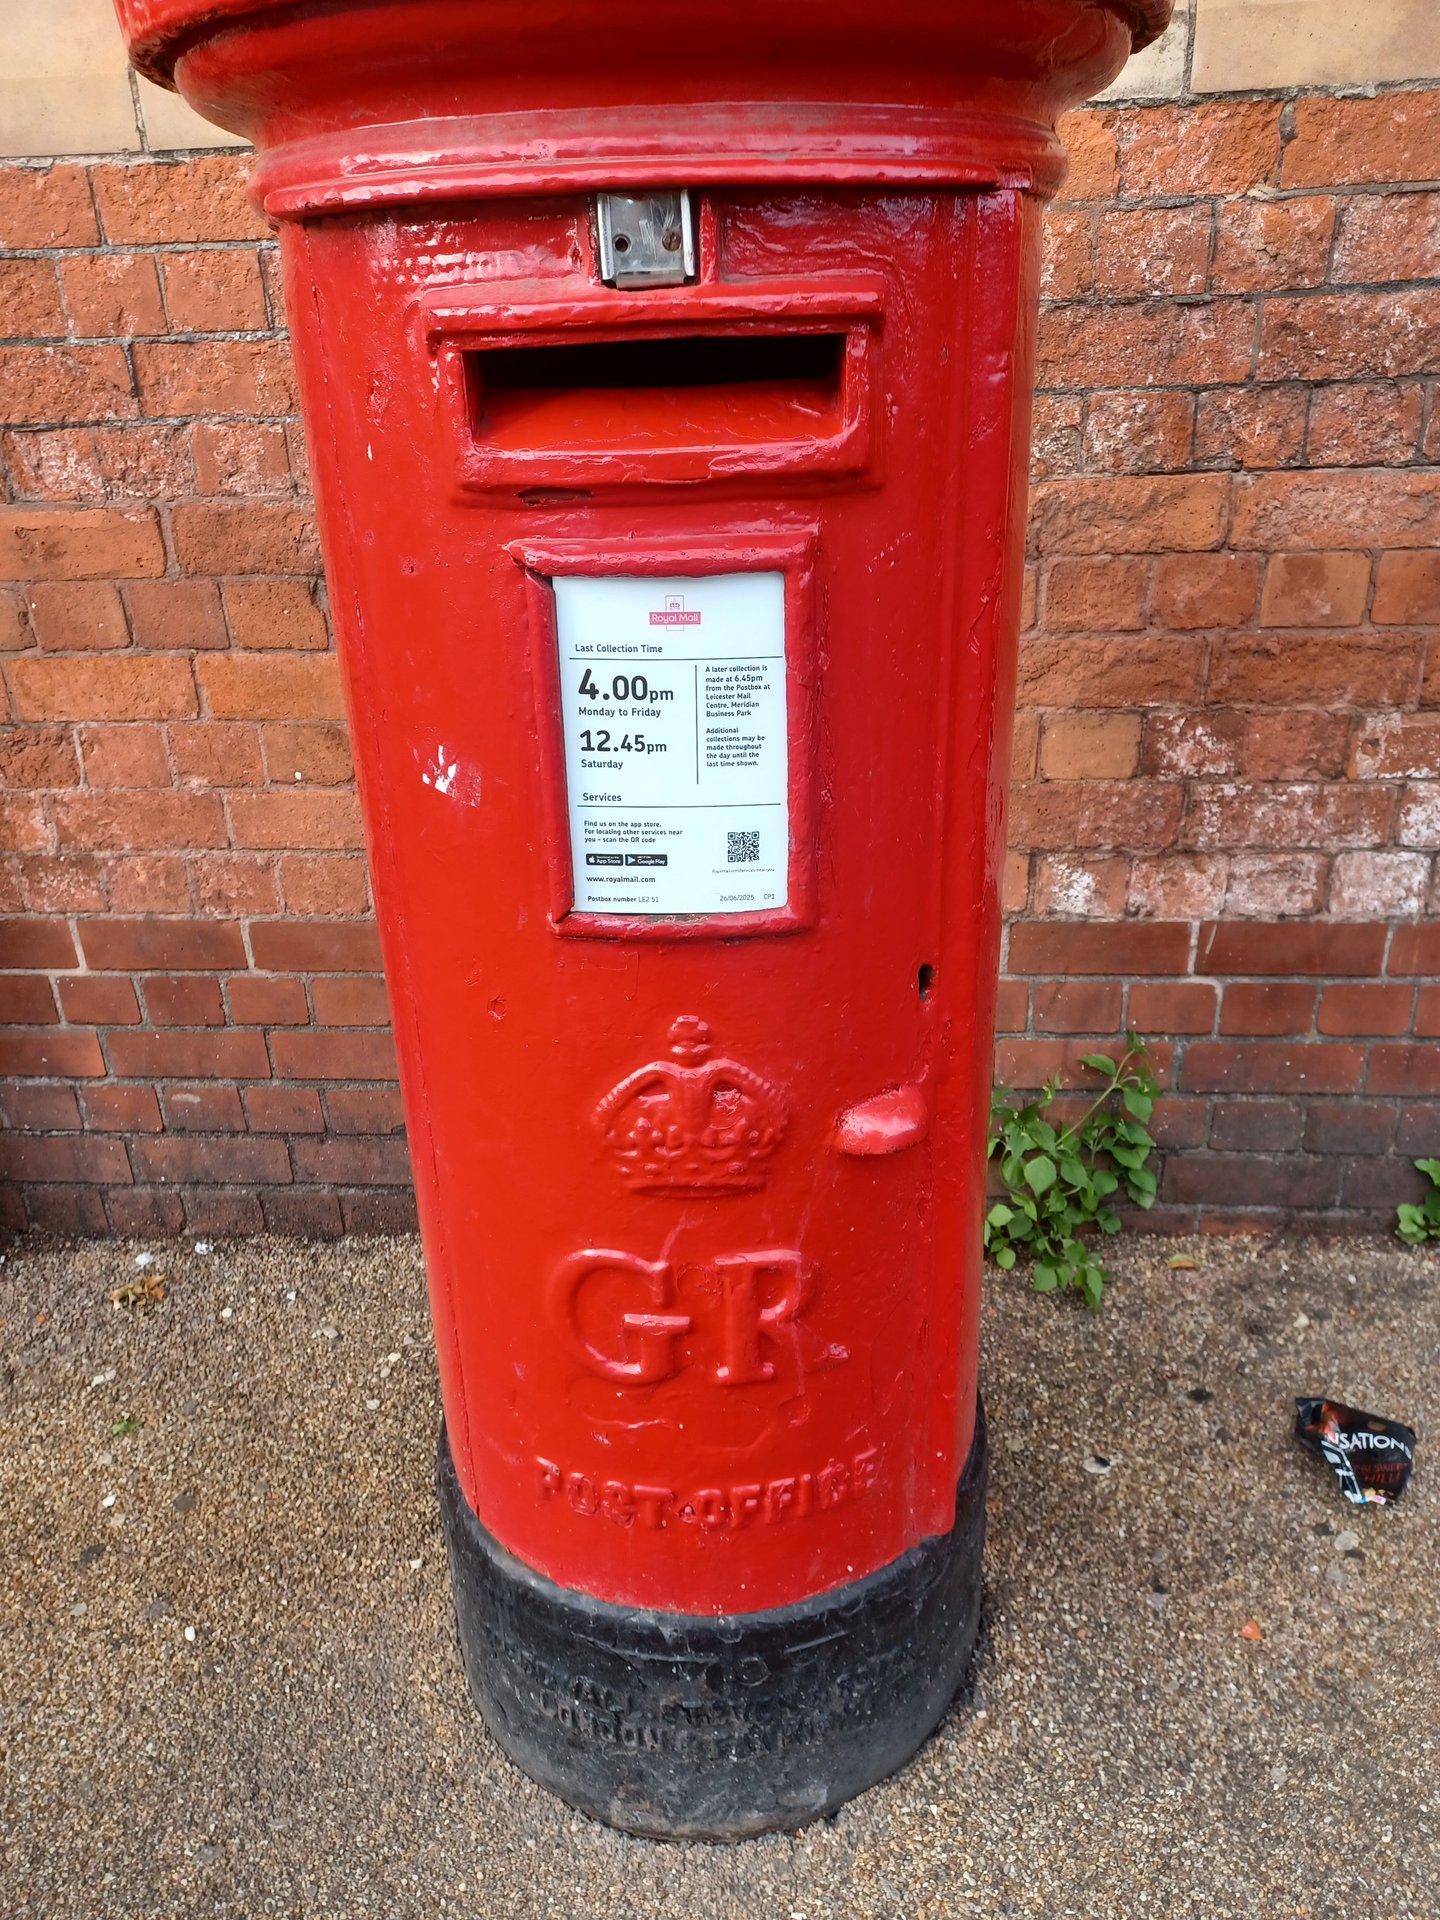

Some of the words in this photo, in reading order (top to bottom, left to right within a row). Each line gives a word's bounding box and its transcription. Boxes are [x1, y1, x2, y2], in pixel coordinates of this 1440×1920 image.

[652, 614, 676, 624] Royal
[678, 614, 698, 622] Mail
[575, 644, 594, 652] Last
[596, 644, 638, 652] Collection
[641, 644, 662, 653] Time
[734, 674, 763, 682] 6.45pm
[578, 668, 674, 703] 4.00pm
[578, 707, 616, 718] Monday
[618, 708, 628, 716] to
[631, 708, 662, 718] Friday
[580, 730, 667, 754] 12.45pm
[581, 759, 624, 770] Saturday
[583, 792, 622, 802] Services
[536, 1456, 673, 1530] POST
